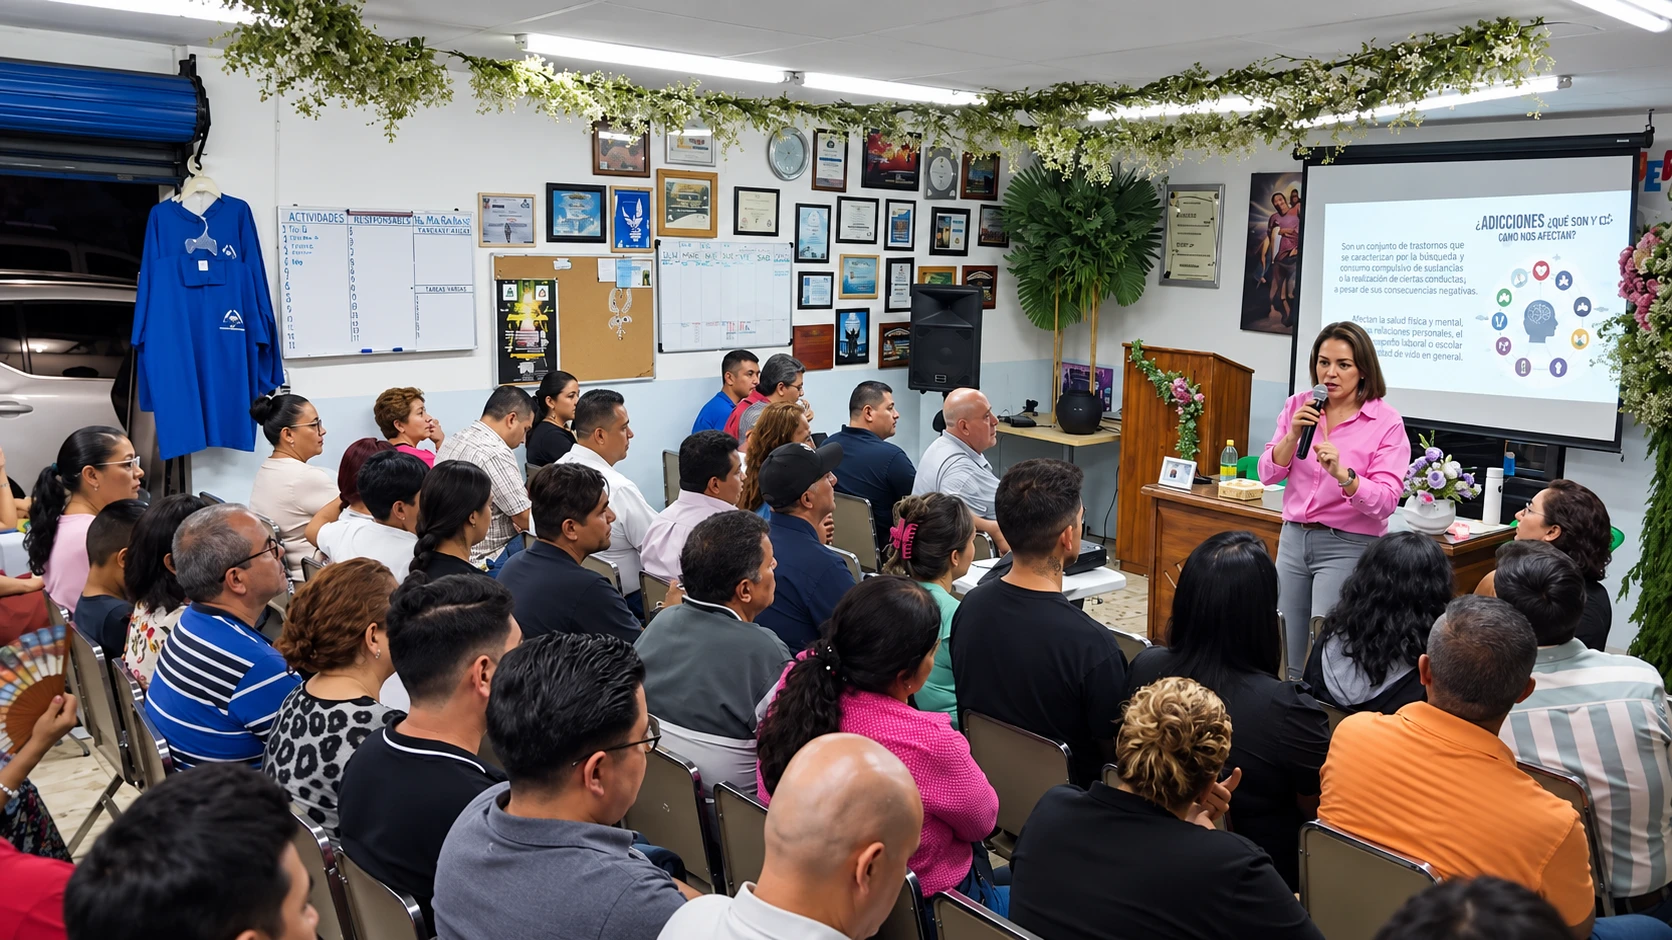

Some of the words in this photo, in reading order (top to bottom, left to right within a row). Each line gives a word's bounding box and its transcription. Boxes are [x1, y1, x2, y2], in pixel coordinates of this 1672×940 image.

[289, 212, 345, 223] ACTIVIDADES
[1476, 214, 1545, 231] ¿ADICCIONES
[1548, 215, 1569, 229] ¿QUÉ
[1571, 217, 1589, 227] SON
[1591, 216, 1597, 226] Y
[1521, 232, 1536, 241] NOS
[1538, 231, 1576, 241] AFECTAN?
[1366, 242, 1397, 252] conjunto
[1399, 242, 1408, 250] de
[1450, 242, 1465, 251] que
[1396, 255, 1408, 263] por
[1411, 253, 1418, 261] la
[1460, 254, 1465, 263] y
[1372, 264, 1412, 274] compulsivo
[1414, 264, 1423, 272] de
[1389, 275, 1399, 283] de
[1400, 275, 1424, 283] ciertas
[1340, 287, 1359, 295] pesar
[1360, 286, 1370, 294] de
[1384, 286, 1438, 295] consecuencias
[1439, 286, 1478, 297] negativas.
[1379, 316, 1385, 324] la
[1387, 317, 1407, 325] salud
[1429, 319, 1434, 328] y
[1436, 318, 1464, 327] mental,
[1374, 326, 1411, 336] relaciones
[1456, 330, 1463, 338] el
[1402, 339, 1427, 348] laboral
[1428, 341, 1434, 349] o
[1436, 341, 1463, 350] escolar
[1433, 353, 1463, 362] general.
